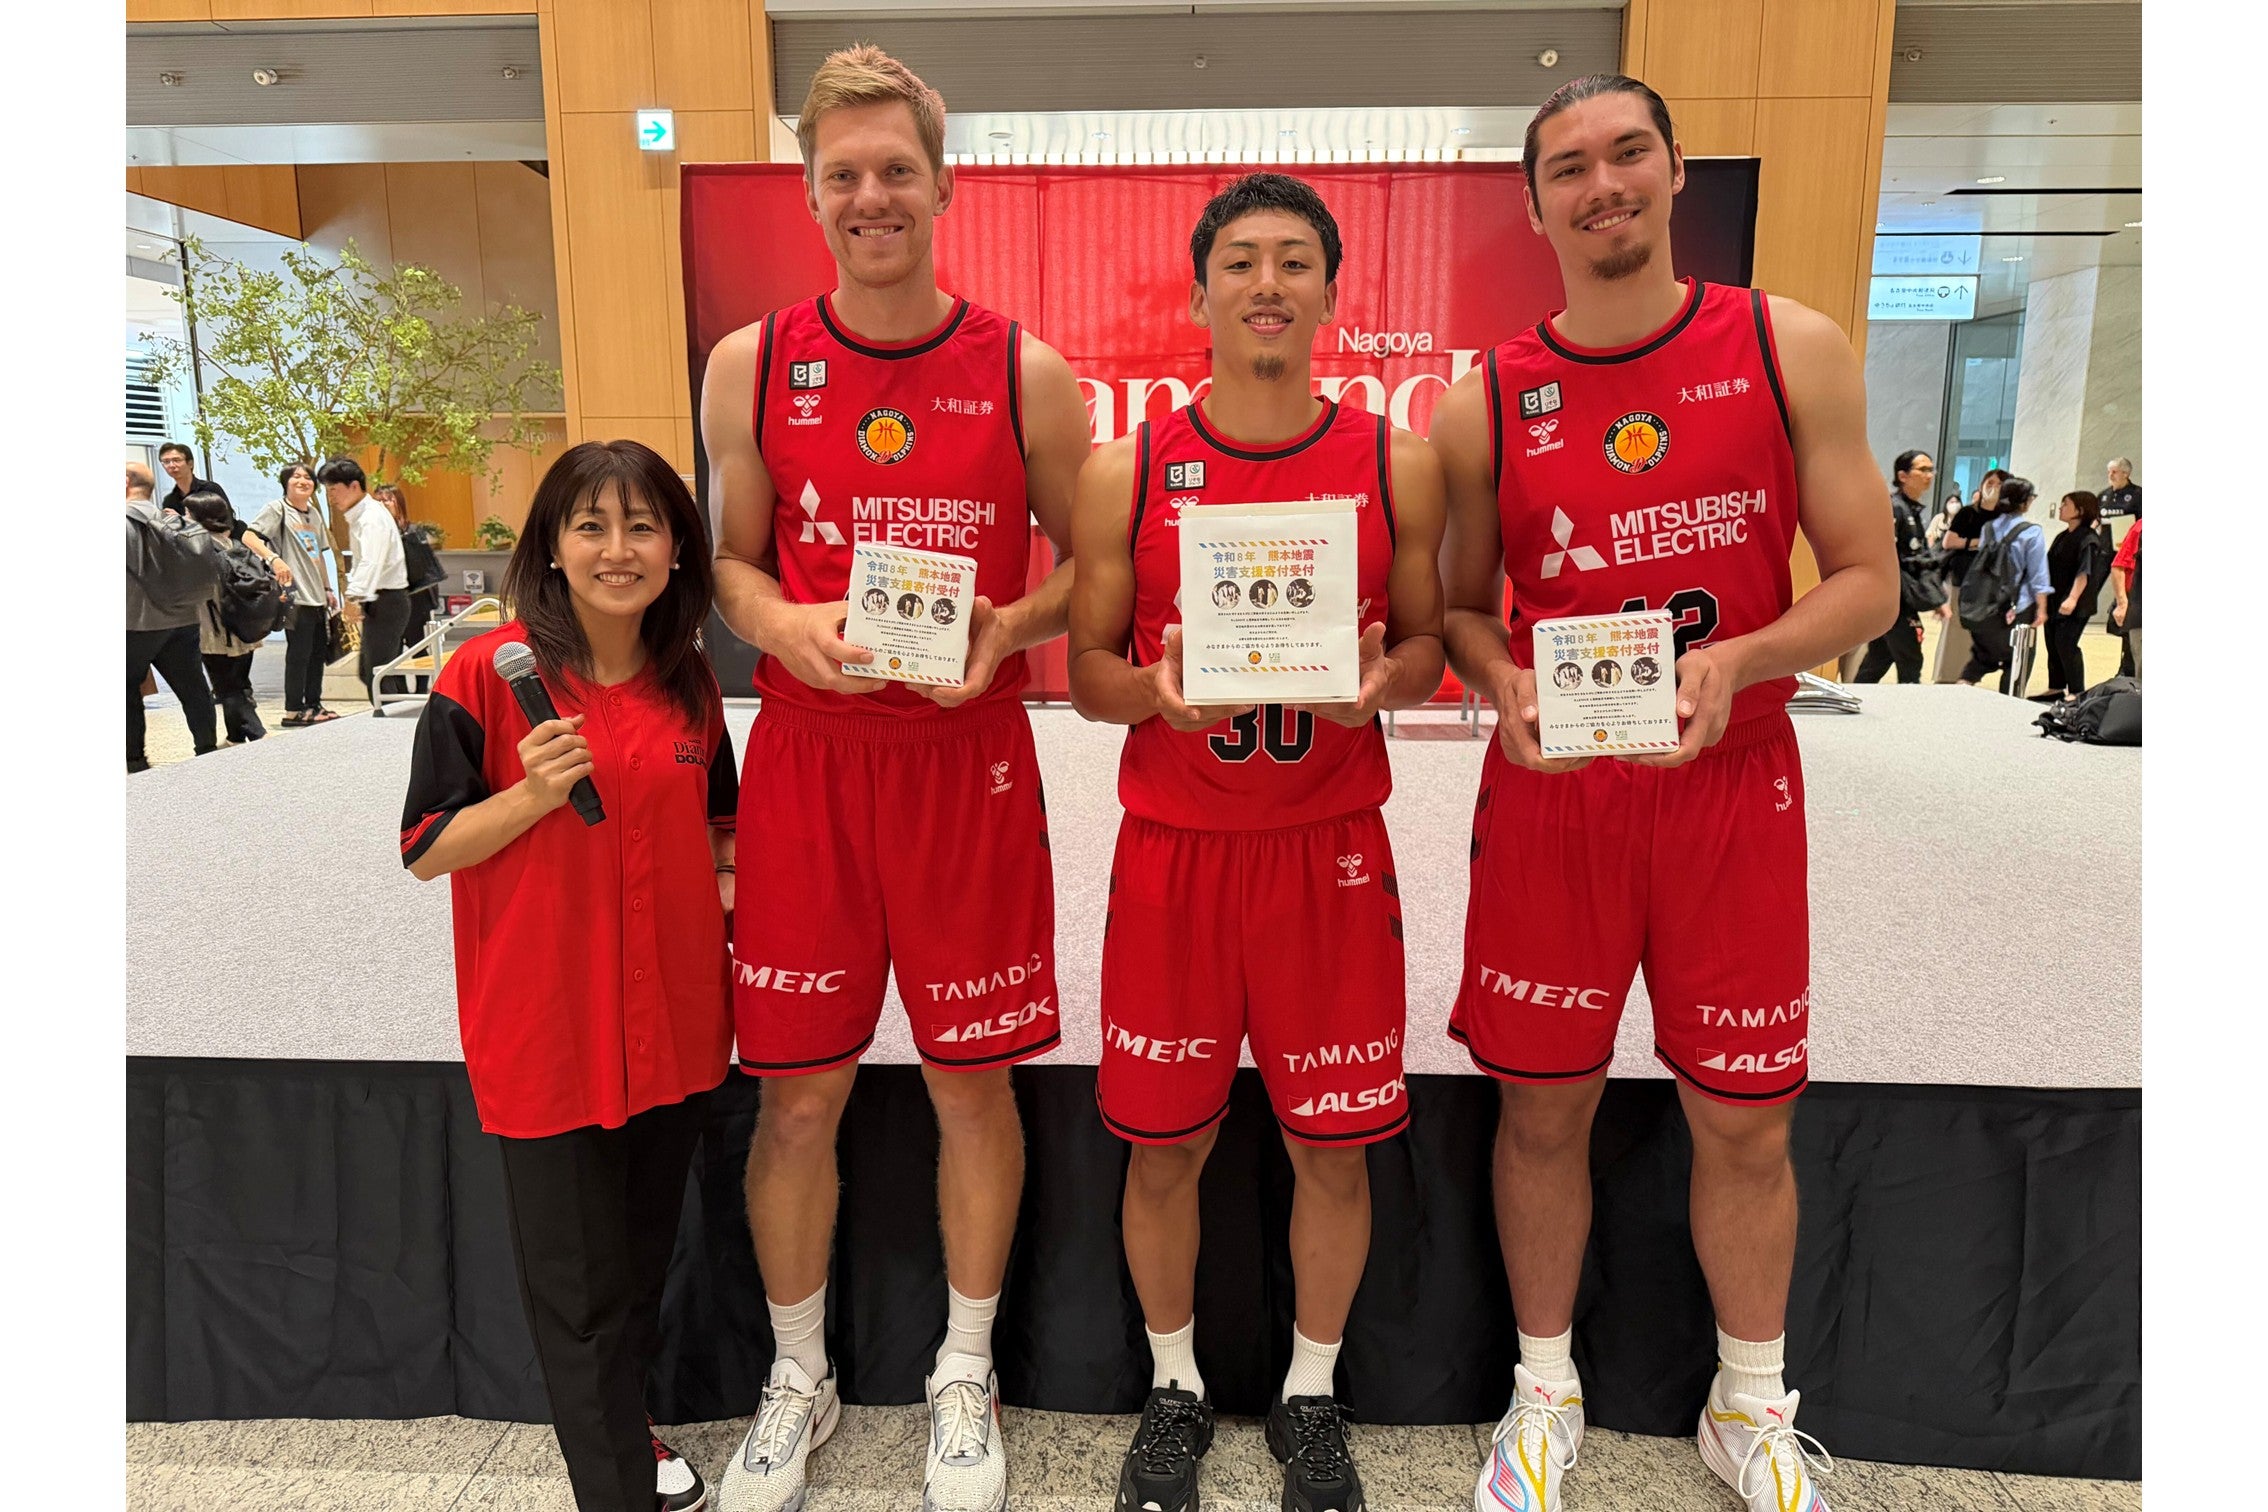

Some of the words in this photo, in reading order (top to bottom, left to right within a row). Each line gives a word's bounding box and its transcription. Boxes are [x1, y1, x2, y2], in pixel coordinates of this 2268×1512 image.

[1338, 326, 1433, 359] Nagoya
[1676, 377, 1750, 404] 大和証券
[869, 409, 904, 422] NAGOYA
[930, 396, 994, 416] 大和証券
[788, 415, 822, 426] hummel
[1614, 413, 1653, 430] NAGOYA
[1526, 438, 1564, 458] hummel
[852, 496, 996, 526] MITSUBISHI
[1609, 488, 1767, 539] MITSUBISHI
[853, 522, 979, 550] ELECTRIC
[1613, 517, 1748, 566] ELECTRIC
[1212, 551, 1256, 563] 令和8年
[1267, 549, 1315, 562] 熊本地震
[867, 561, 908, 576] 令和8年
[918, 567, 962, 584] 熊本地震
[1213, 564, 1315, 579] 災害支援寄付受付
[866, 574, 960, 598] 災害支援寄付受付
[1552, 632, 1597, 647] 令和8年
[1610, 627, 1659, 641] 熊本地震
[1554, 642, 1660, 661] 災害支援寄付受付
[1337, 873, 1370, 888] hummel
[926, 953, 1042, 1001] TAMADIC
[959, 995, 1055, 1042] ALSOK
[1283, 1027, 1398, 1073] TAMADIC
[1727, 1038, 1808, 1073] ALSO
